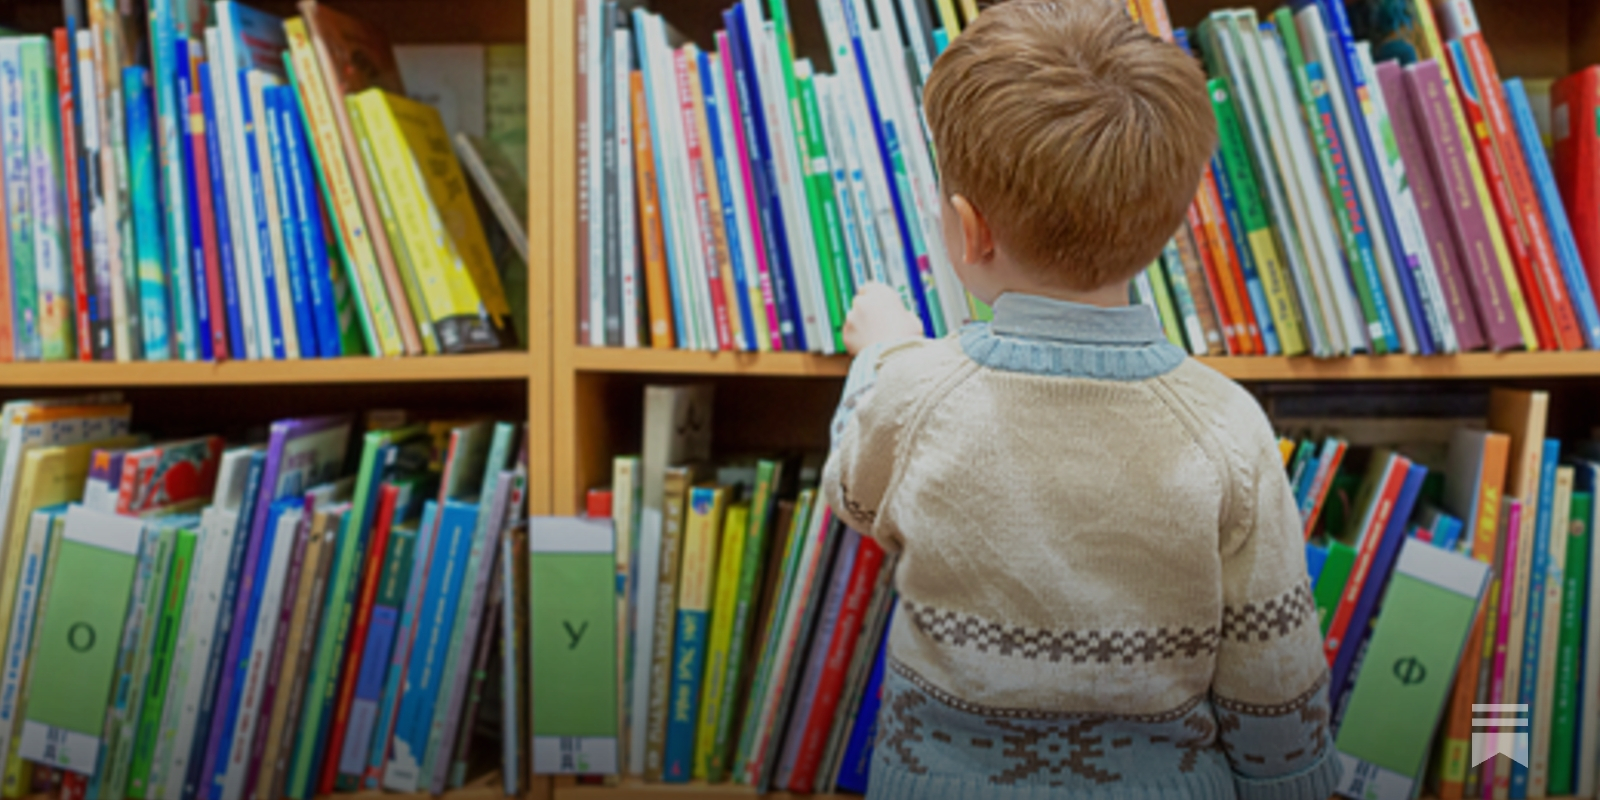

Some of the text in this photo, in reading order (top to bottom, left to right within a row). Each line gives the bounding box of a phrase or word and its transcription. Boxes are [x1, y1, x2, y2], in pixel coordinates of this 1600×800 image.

[67, 621, 97, 653] О
[562, 620, 589, 650] У
[1392, 655, 1429, 687] Ф
